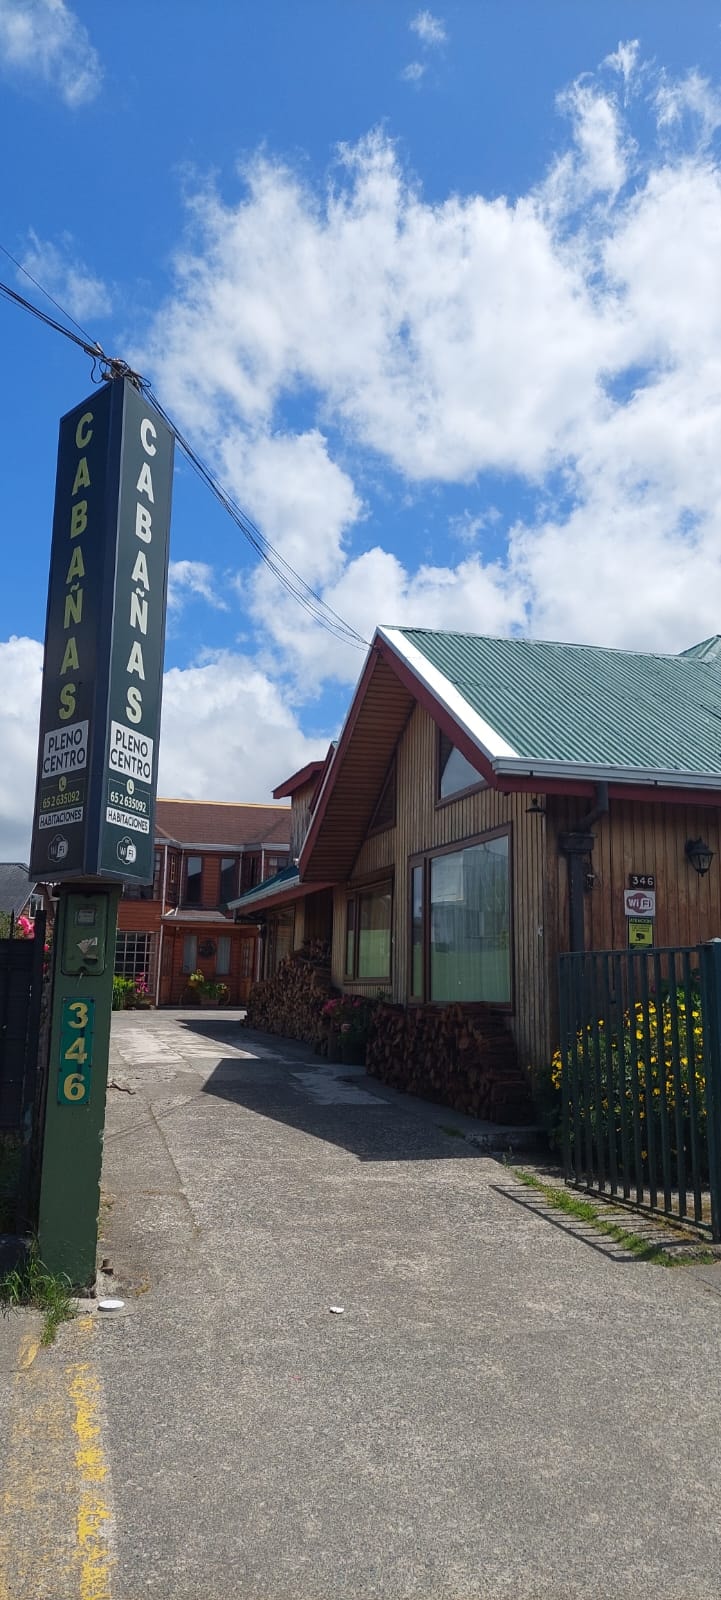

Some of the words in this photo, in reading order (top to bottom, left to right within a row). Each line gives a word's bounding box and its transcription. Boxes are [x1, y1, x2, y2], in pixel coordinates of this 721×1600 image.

[58, 411, 95, 721] CABAÑAS
[125, 417, 157, 724] CABAÑAS
[48, 728, 83, 754] PLENO
[115, 729, 149, 757] PLENO
[43, 747, 86, 774] CENTRO
[110, 750, 151, 779] CENTRO
[40, 809, 82, 828] HABITACIONES
[108, 809, 148, 832] HABITACIONES
[632, 876, 654, 886] 346
[62, 1001, 89, 1101] 346
